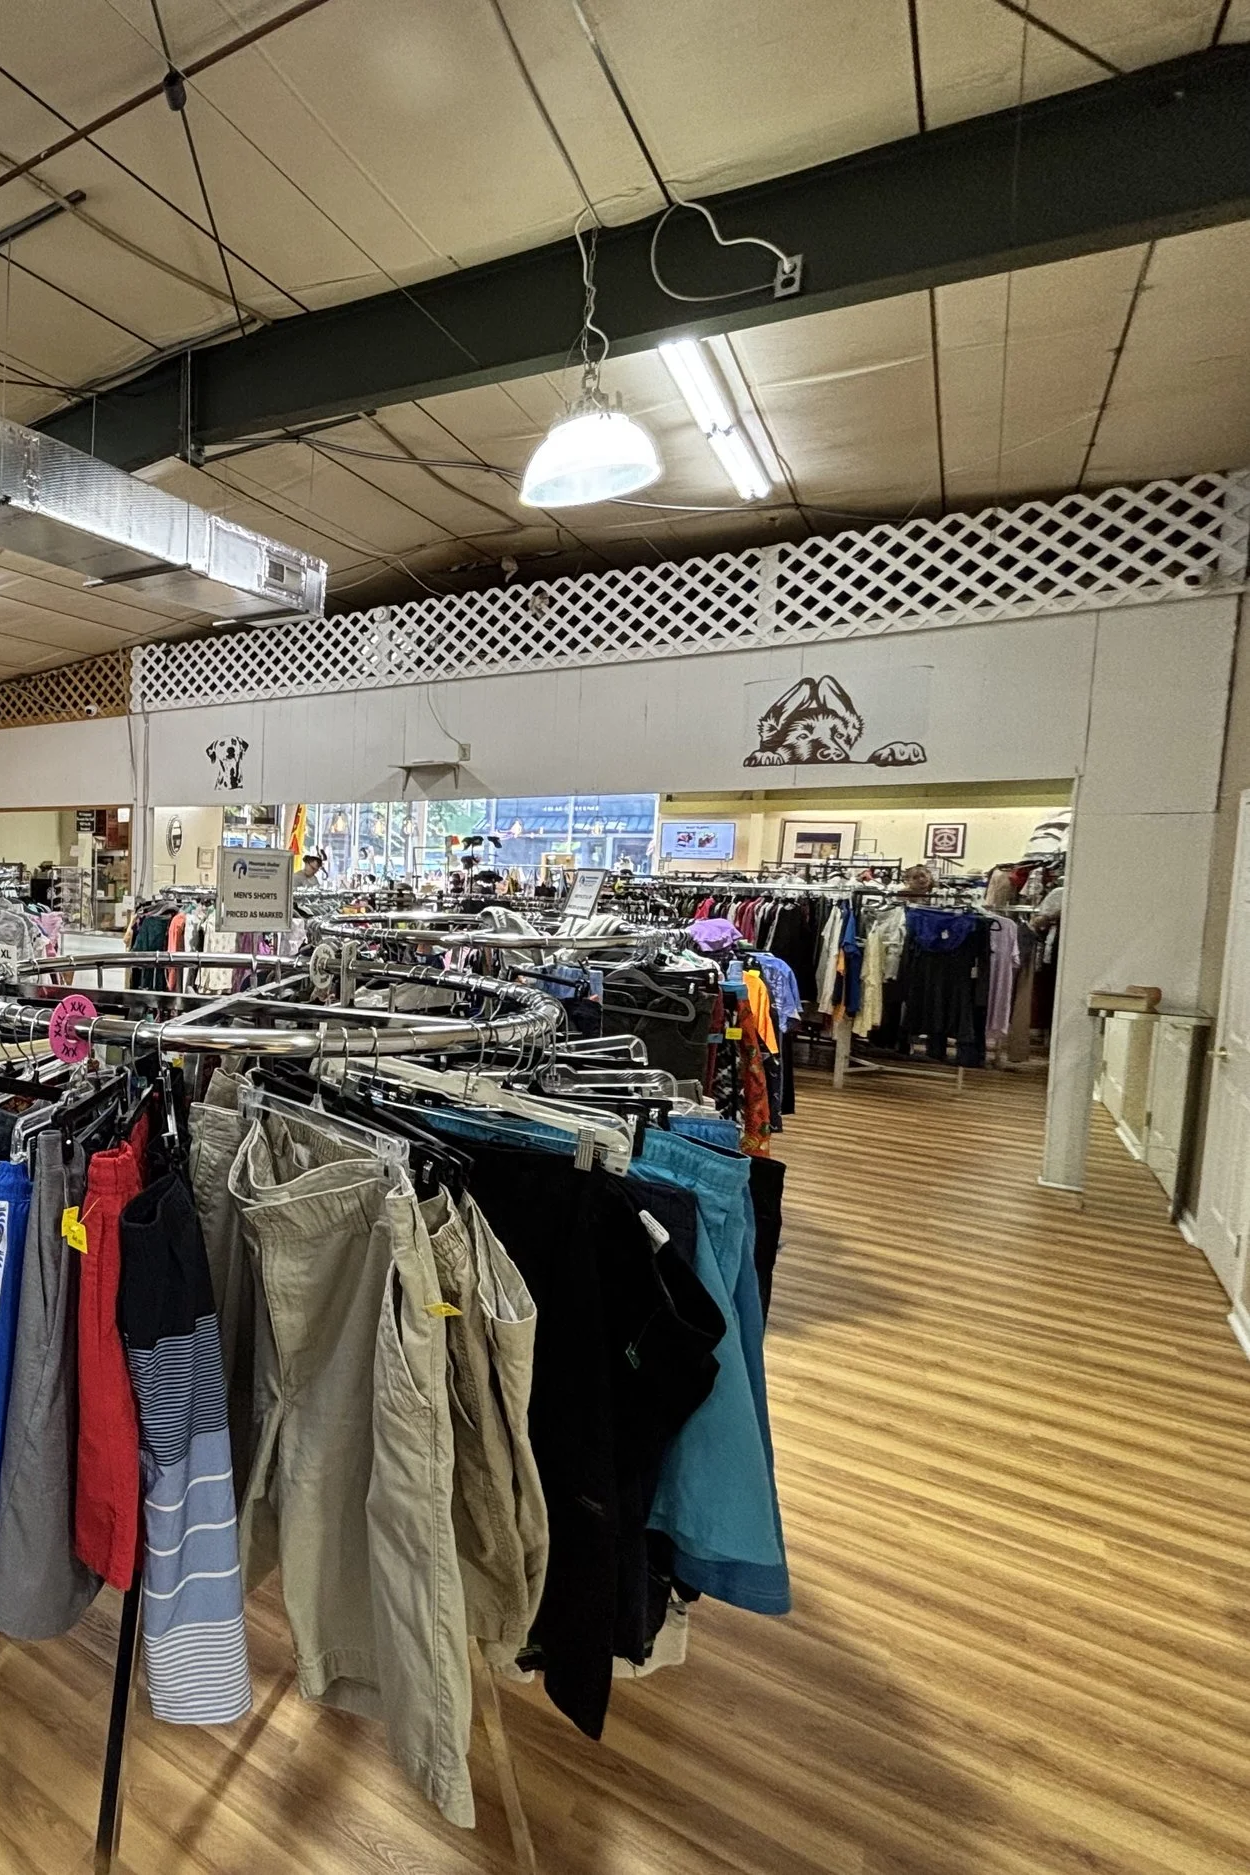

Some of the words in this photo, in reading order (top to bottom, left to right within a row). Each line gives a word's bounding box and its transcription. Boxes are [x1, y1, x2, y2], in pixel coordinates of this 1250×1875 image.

[253, 892, 277, 900] SHORTS
[250, 911, 258, 919] AS
[259, 911, 283, 919] MARKED
[1, 949, 11, 959] XL
[71, 1002, 86, 1015] XXL
[54, 1016, 65, 1037] XXL
[62, 1044, 77, 1057] XXL
